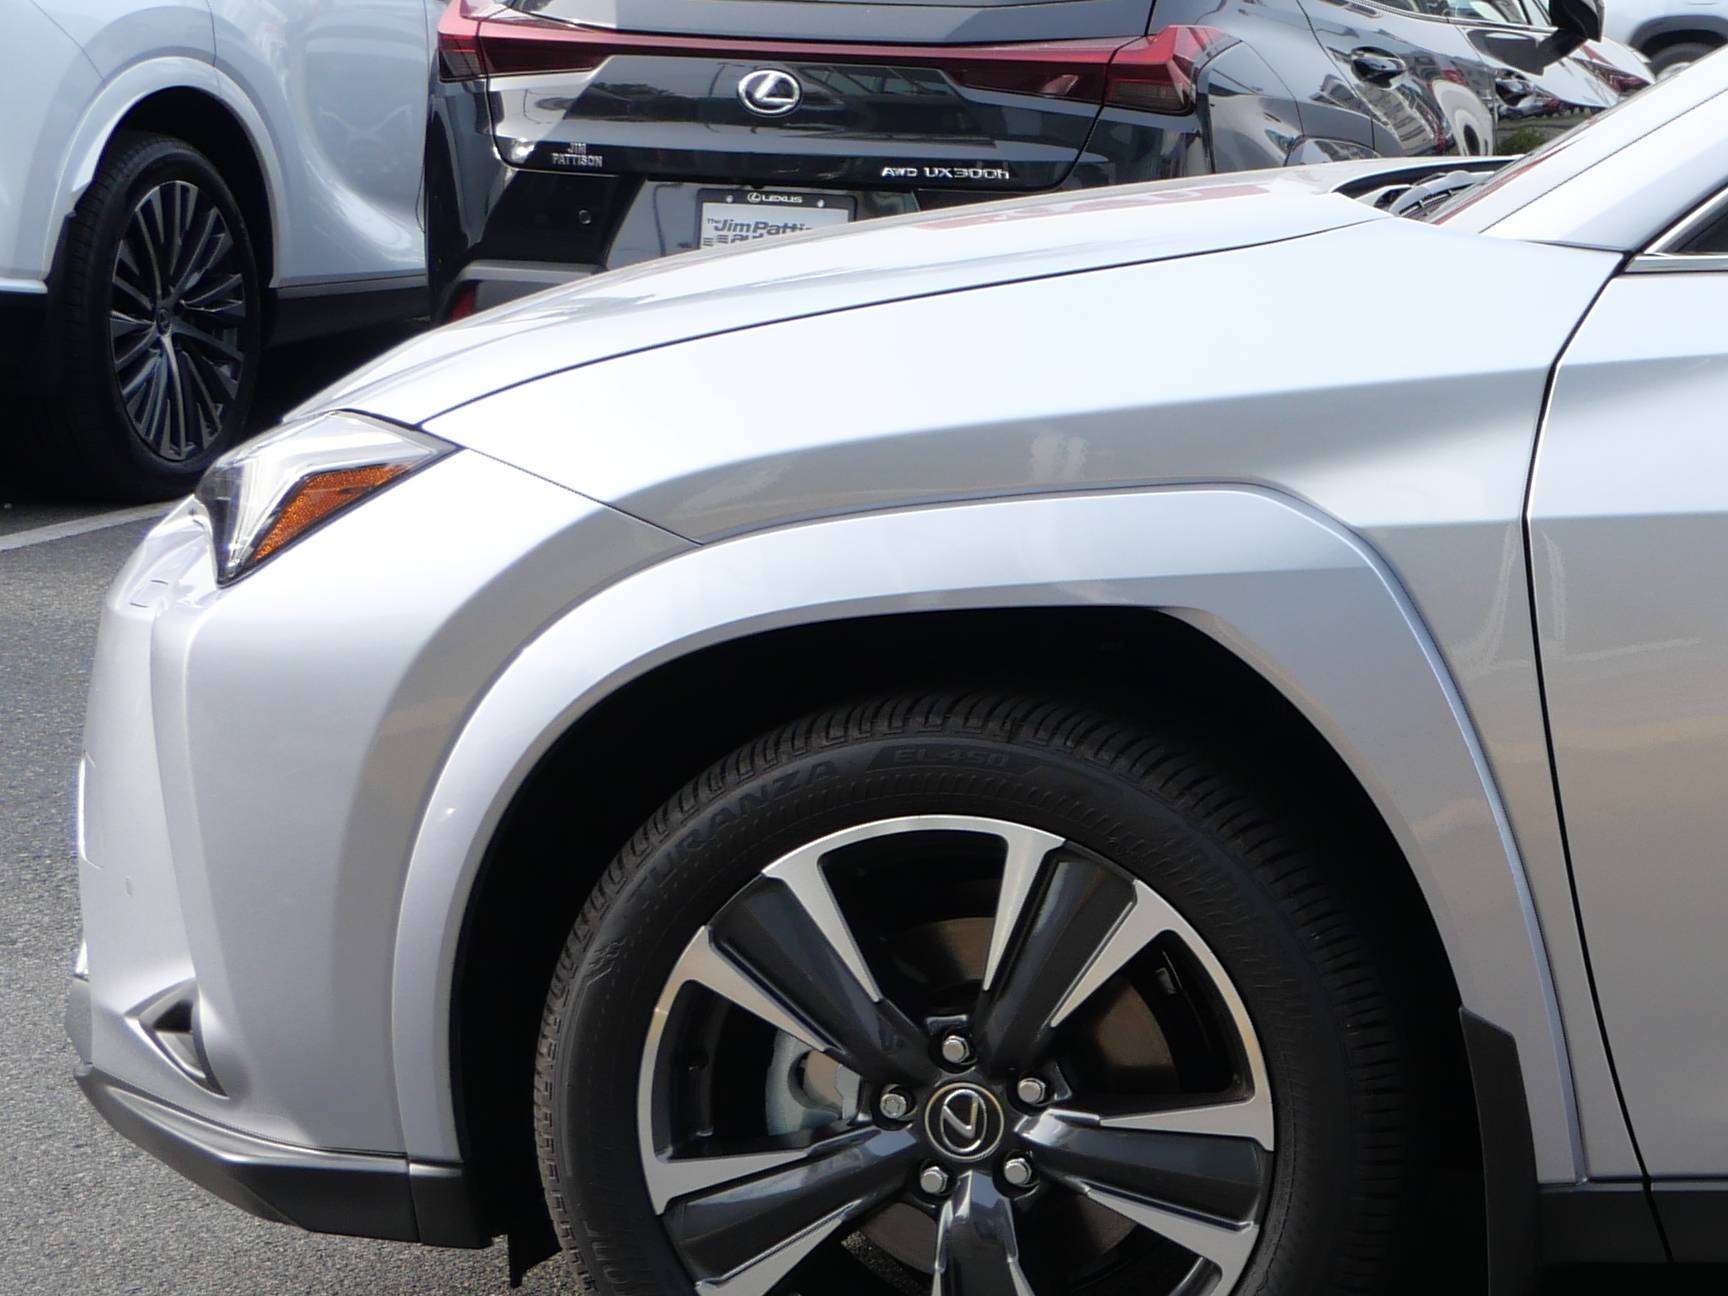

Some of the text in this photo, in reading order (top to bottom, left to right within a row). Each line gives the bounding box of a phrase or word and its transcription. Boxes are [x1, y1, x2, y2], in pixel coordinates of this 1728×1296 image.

[552, 152, 603, 168] PATTISON
[881, 167, 918, 177] AWD
[761, 194, 804, 203] LEXUS
[627, 758, 838, 910] TURANZA
